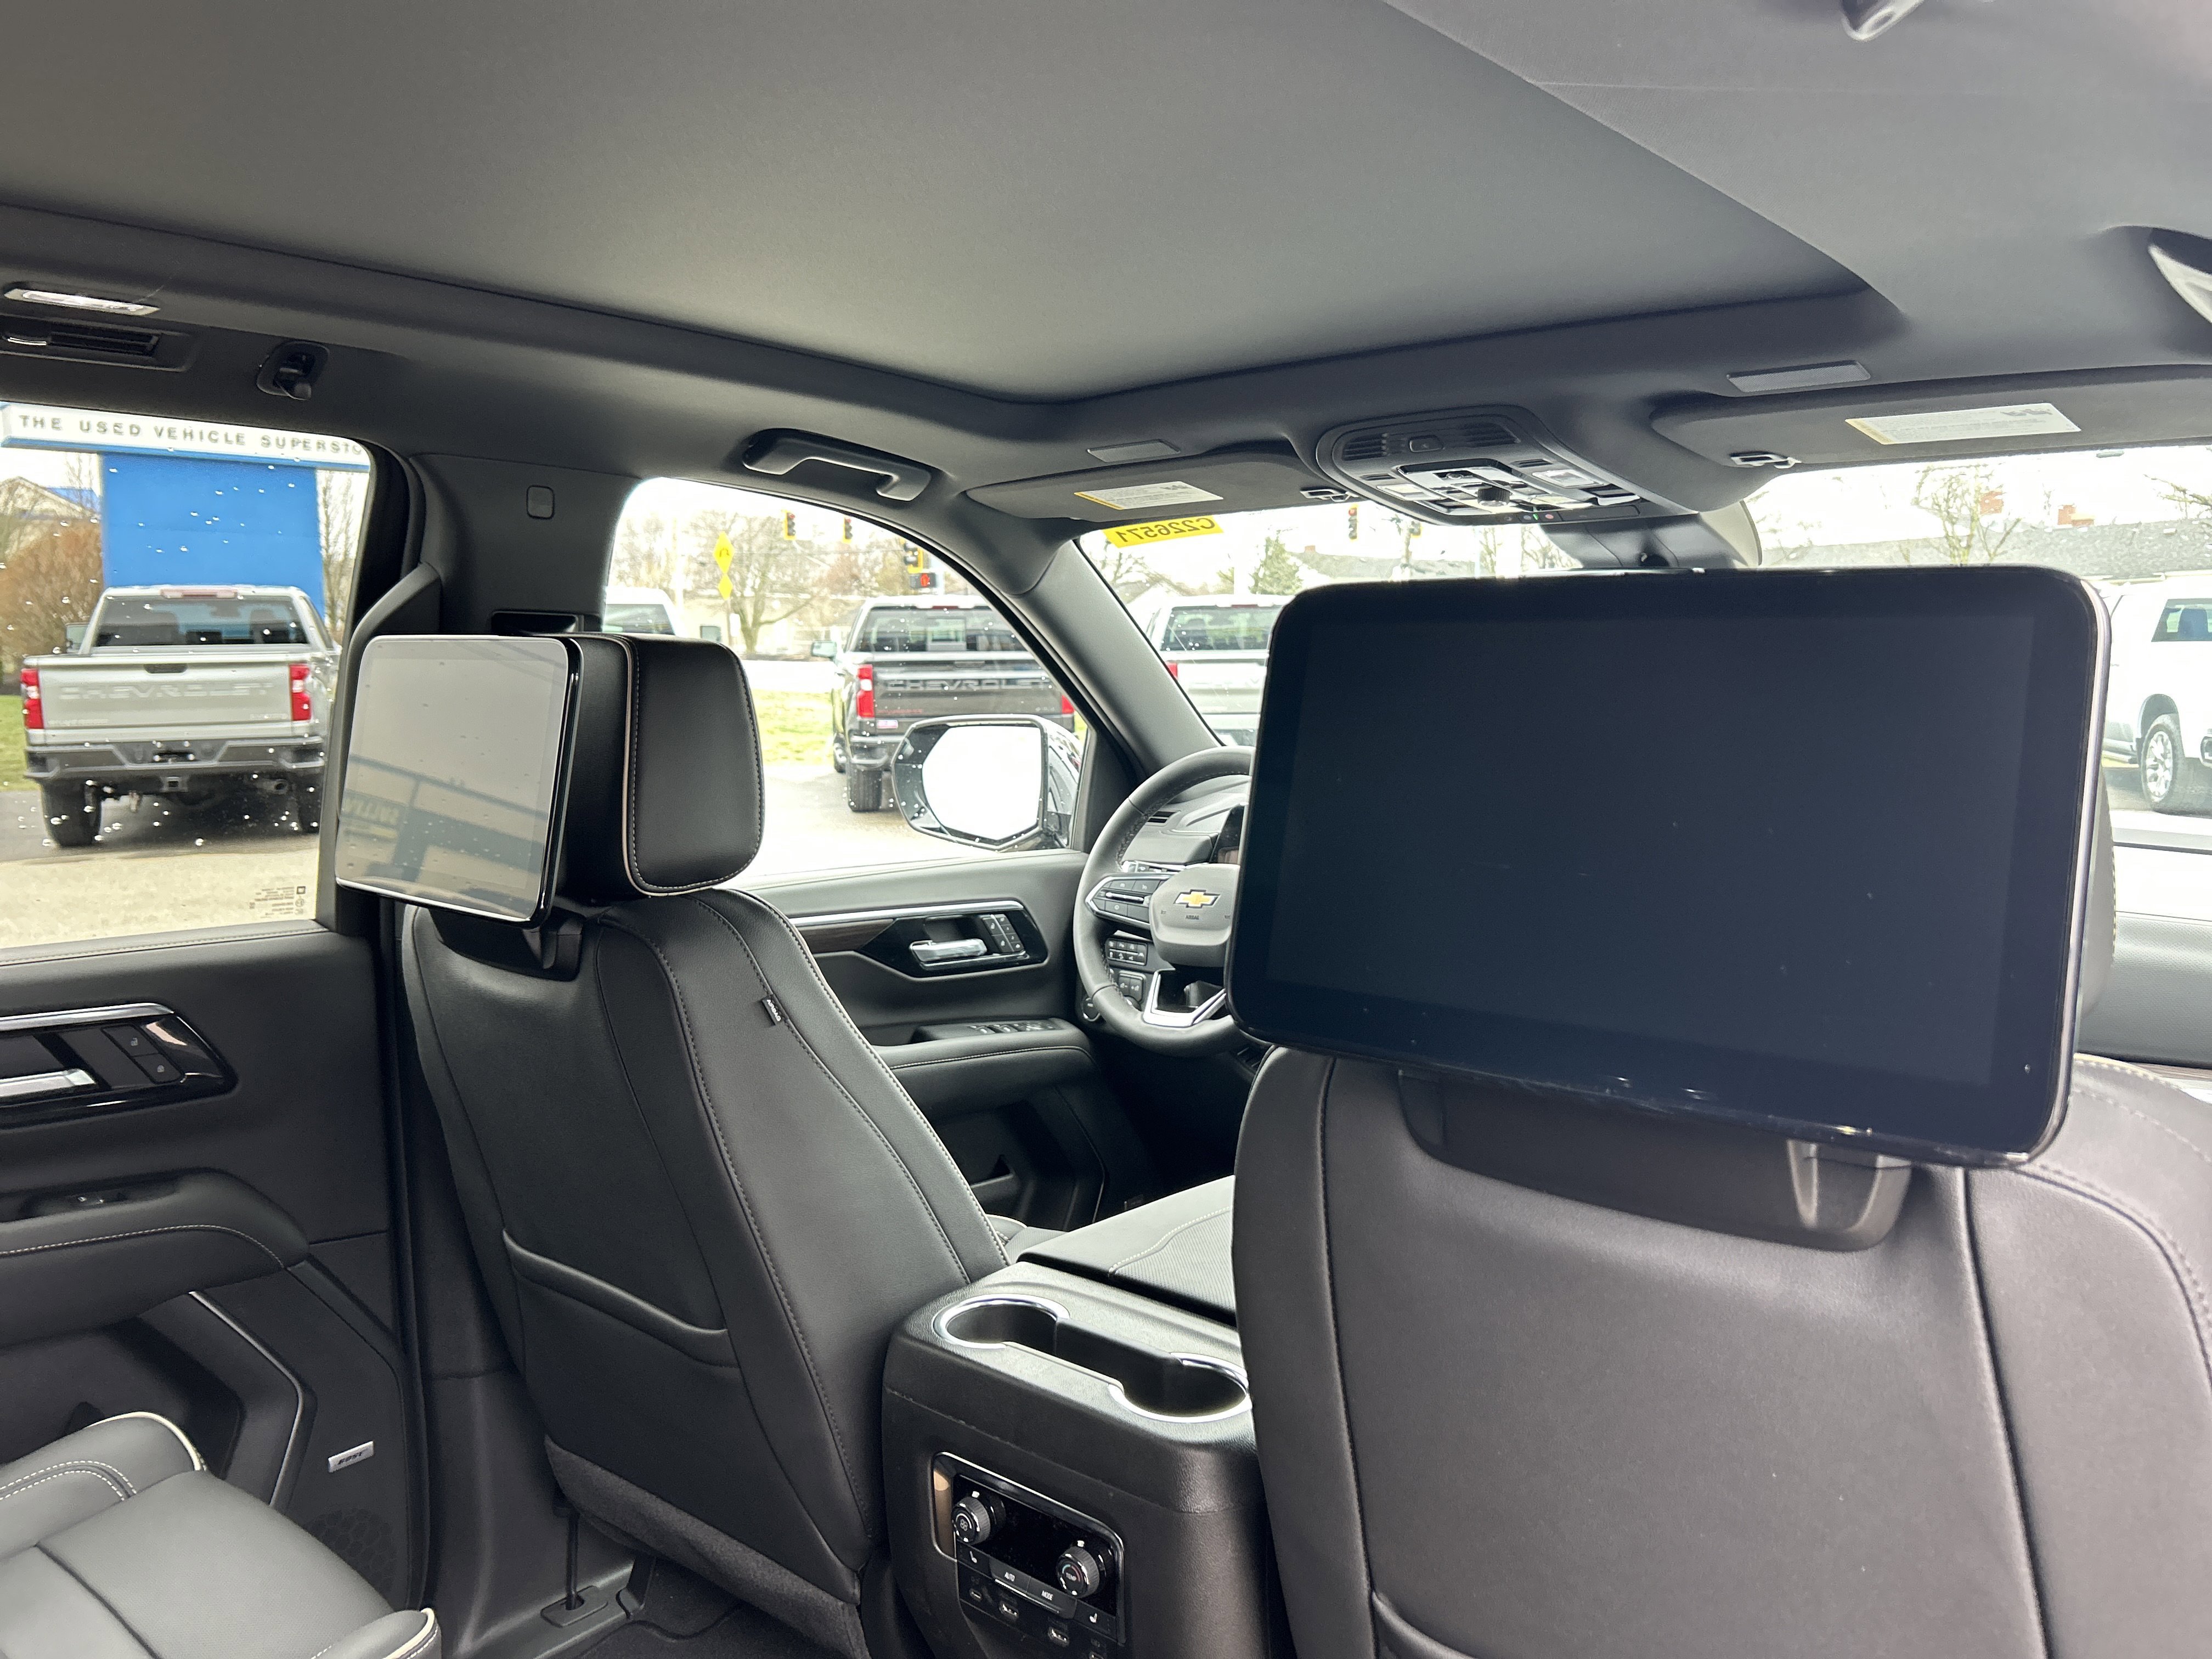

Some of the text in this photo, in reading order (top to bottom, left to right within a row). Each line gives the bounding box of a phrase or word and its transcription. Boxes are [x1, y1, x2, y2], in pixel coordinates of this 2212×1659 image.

[19, 415, 63, 431] THE
[79, 420, 141, 437] USED
[154, 425, 246, 445] VEHICLE
[1004, 1572, 1015, 1582] AUTO
[1041, 1590, 1054, 1601] MODE
